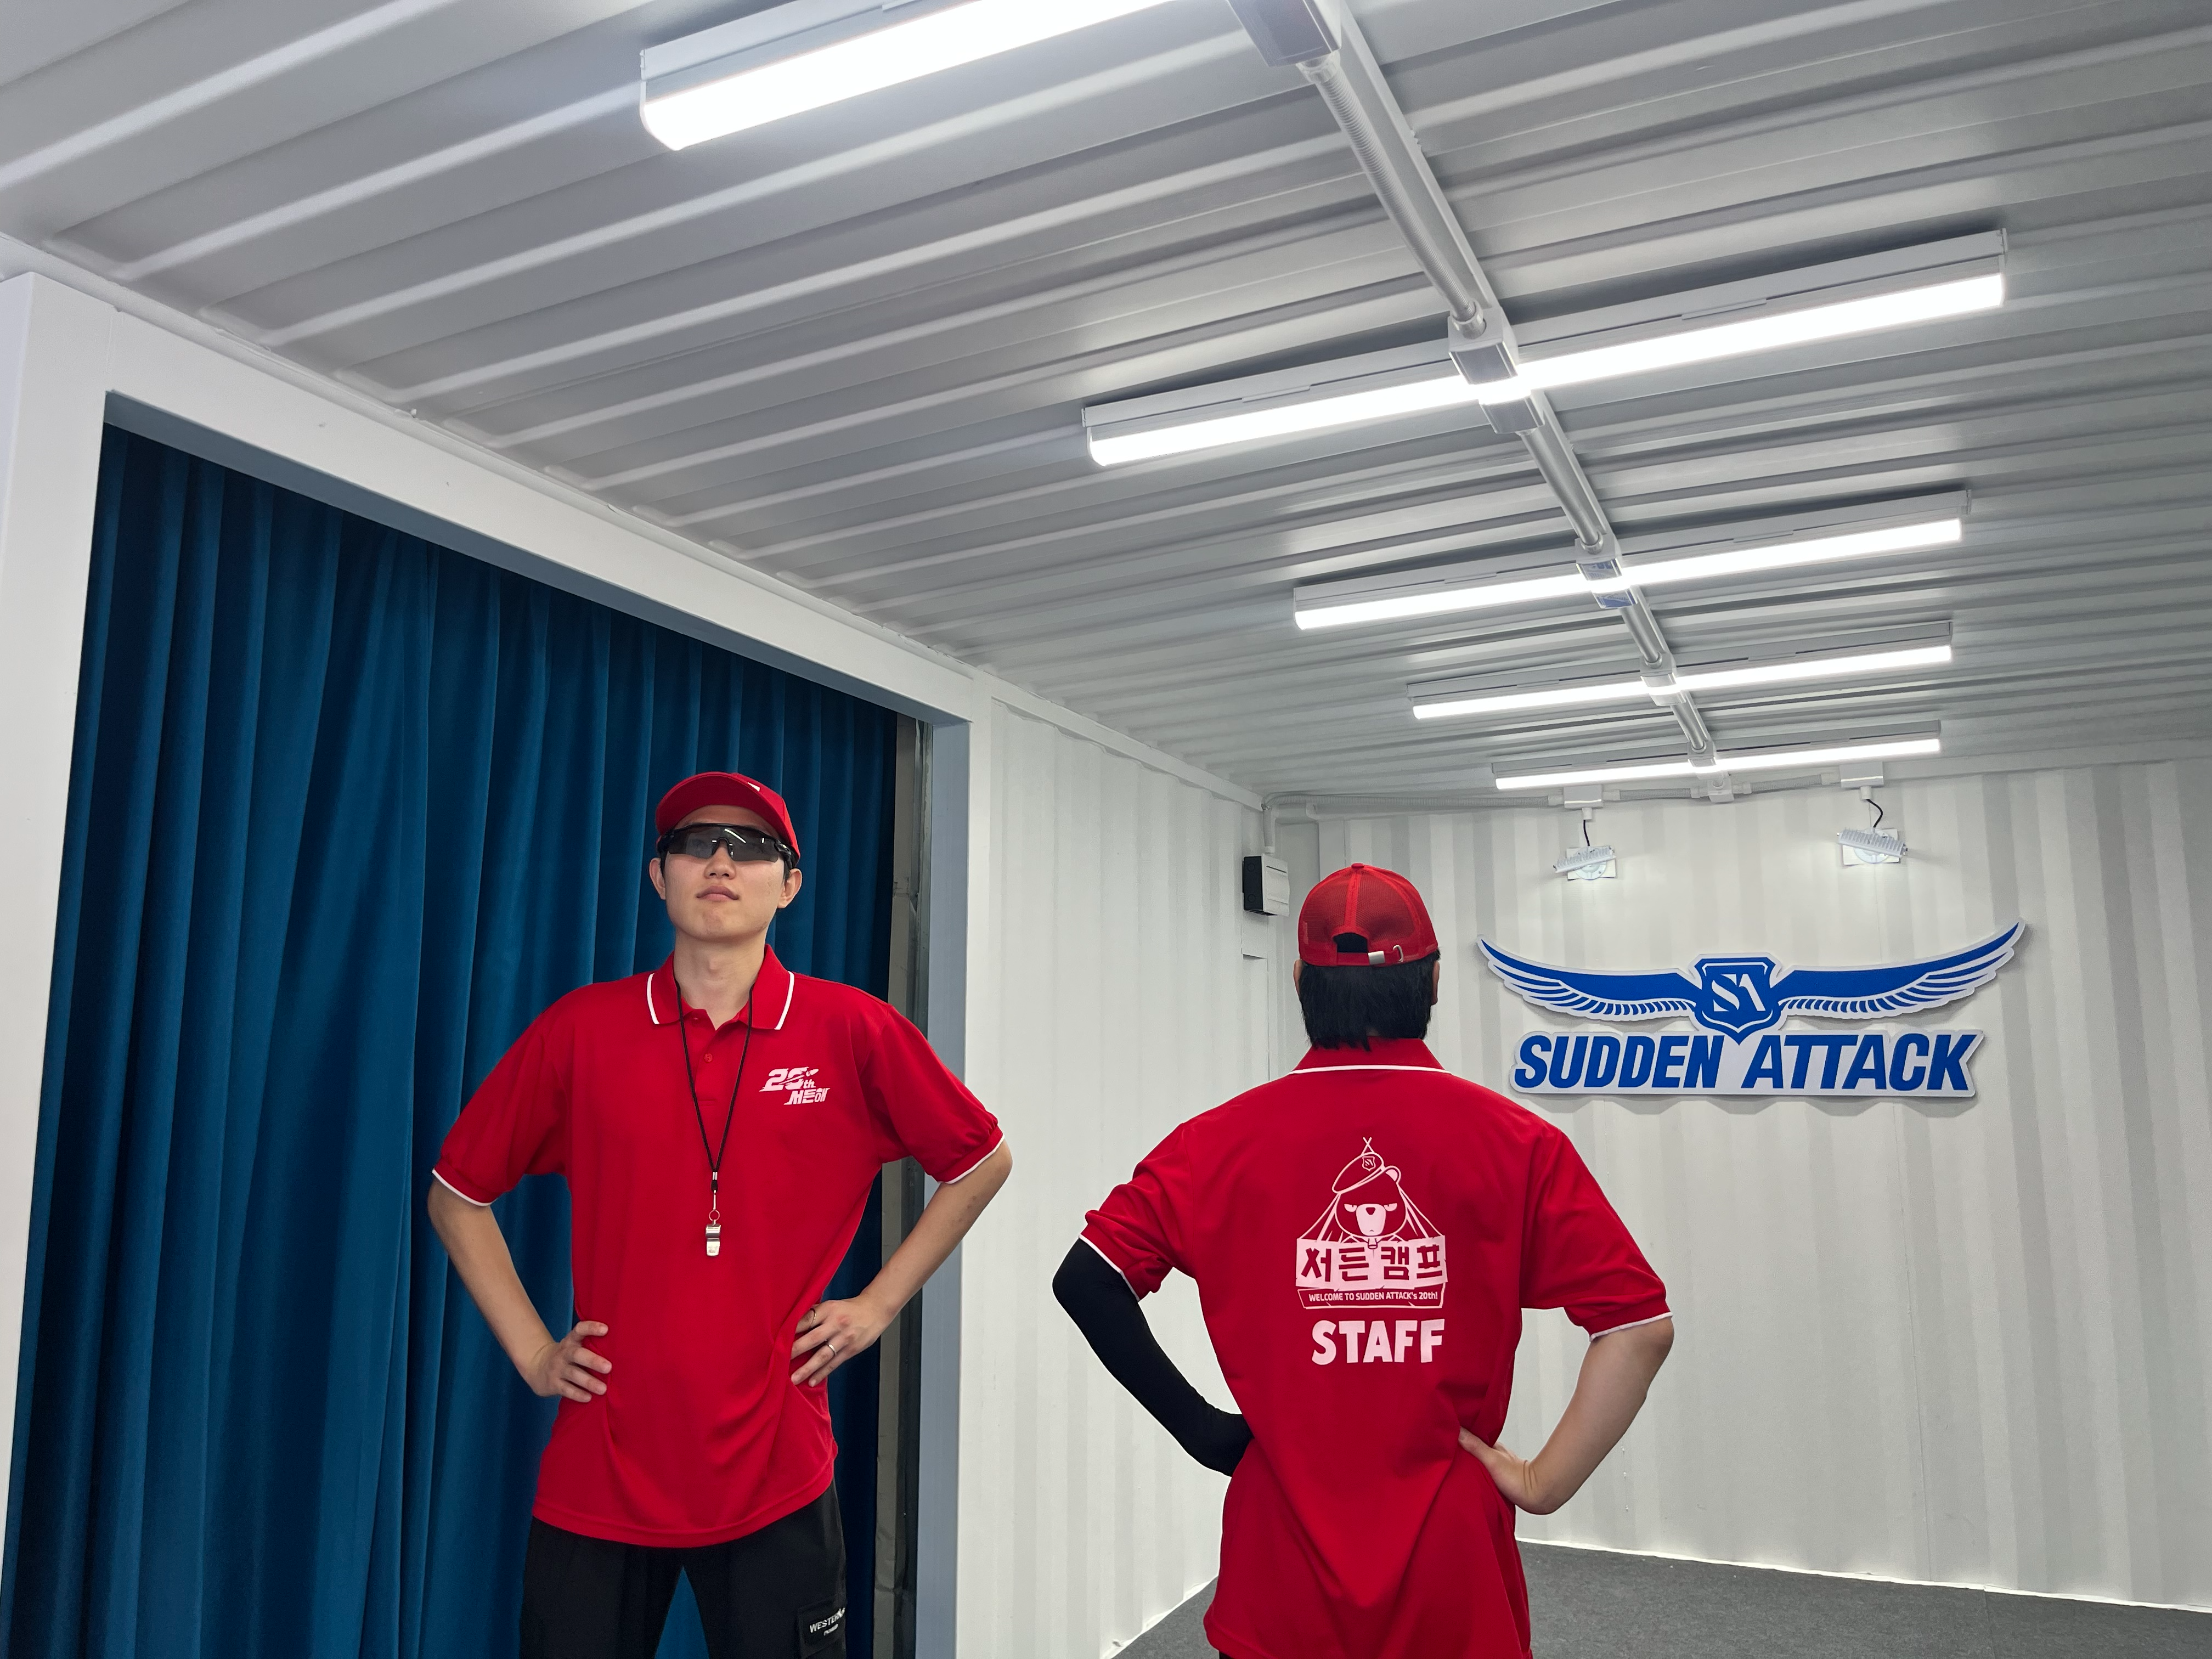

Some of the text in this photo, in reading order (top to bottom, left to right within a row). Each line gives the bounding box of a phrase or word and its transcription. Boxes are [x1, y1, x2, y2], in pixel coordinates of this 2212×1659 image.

[1514, 1034, 1977, 1091] SUDDEN ATTACK
[1309, 1291, 1438, 1302] WELCOME TO SUDDEN ATTACK's 20th!
[1312, 1318, 1445, 1365] STAFF
